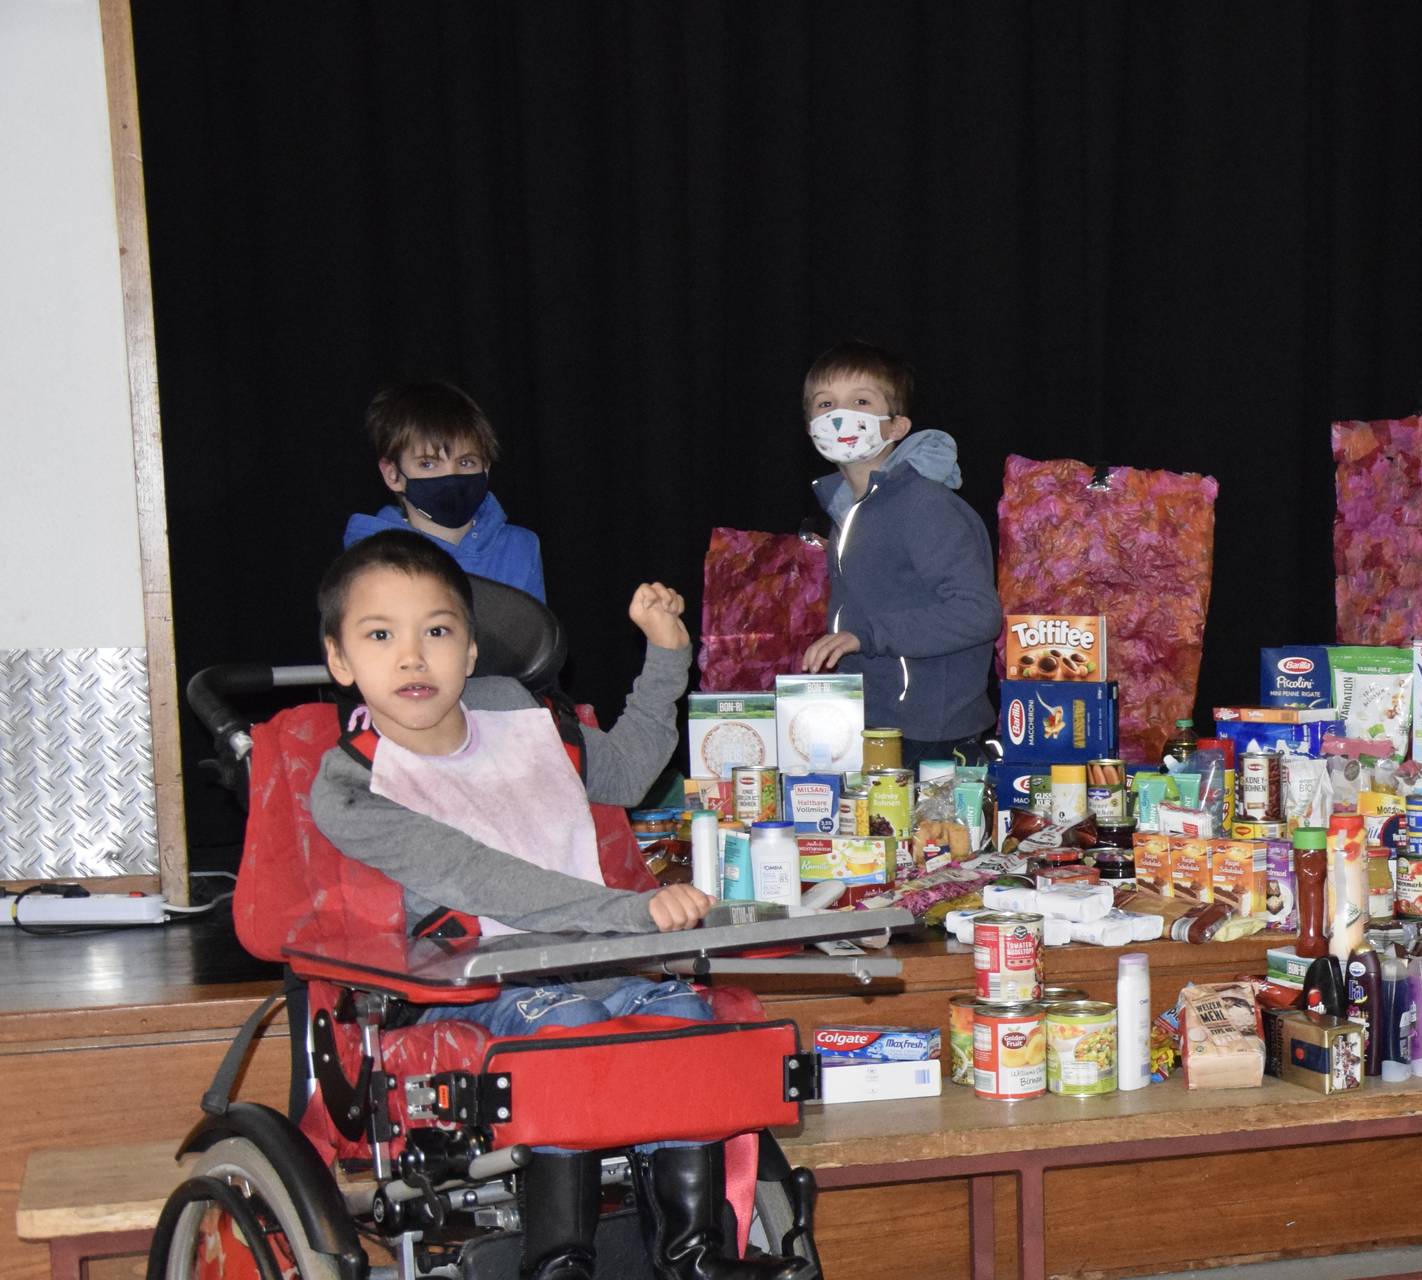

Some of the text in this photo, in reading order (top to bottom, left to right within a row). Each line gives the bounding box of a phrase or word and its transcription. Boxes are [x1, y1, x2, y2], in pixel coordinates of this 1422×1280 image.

[1011, 619, 1095, 649] Toffifee
[1286, 661, 1311, 670] Barilla
[1277, 676, 1314, 689] Piccolini
[1343, 677, 1353, 721] VARIATION
[720, 702, 743, 713] BON-RI
[1012, 703, 1020, 734] Barilla
[796, 806, 829, 814] Vollmilch
[1349, 980, 1364, 1001] Fa
[1200, 1010, 1227, 1023] MEHL
[817, 1032, 868, 1046] Colgate
[1003, 1034, 1026, 1042] Golden
